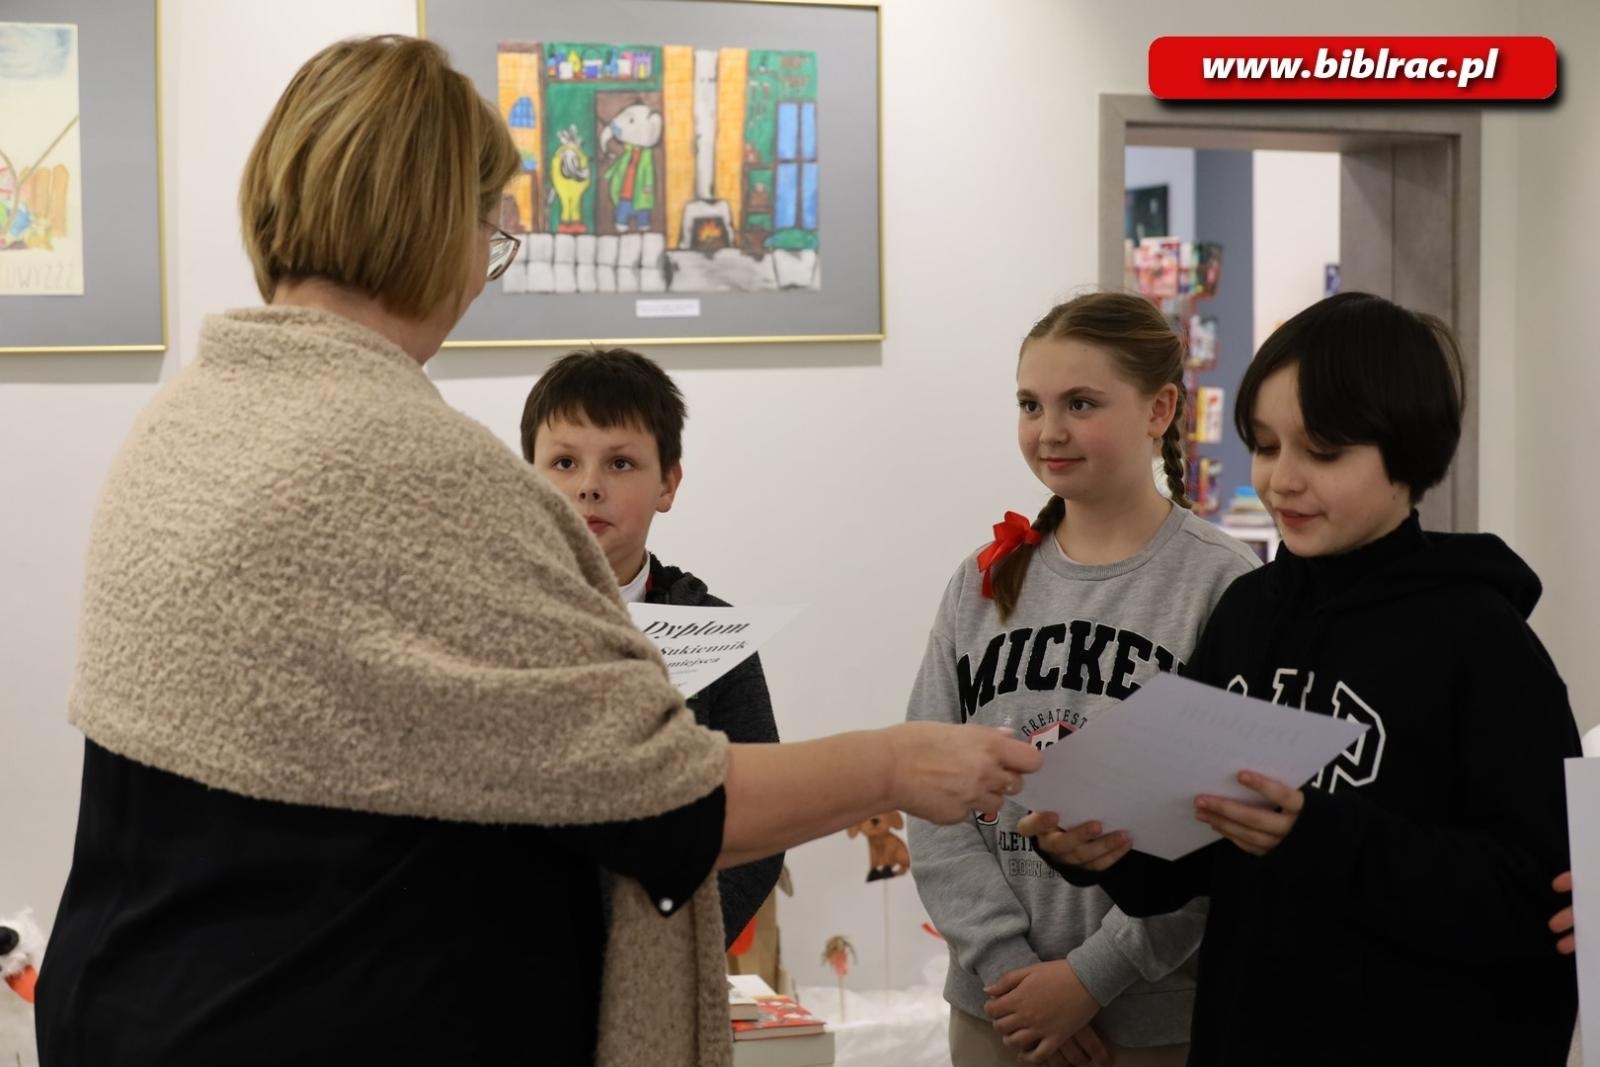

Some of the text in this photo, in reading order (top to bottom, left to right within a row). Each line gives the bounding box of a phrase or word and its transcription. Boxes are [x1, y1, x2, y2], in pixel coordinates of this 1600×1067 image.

[643, 620, 751, 640] Dyplom
[660, 640, 748, 656] Sukiennik
[957, 619, 1188, 725] MICKE
[1021, 708, 1089, 738] GREATEST
